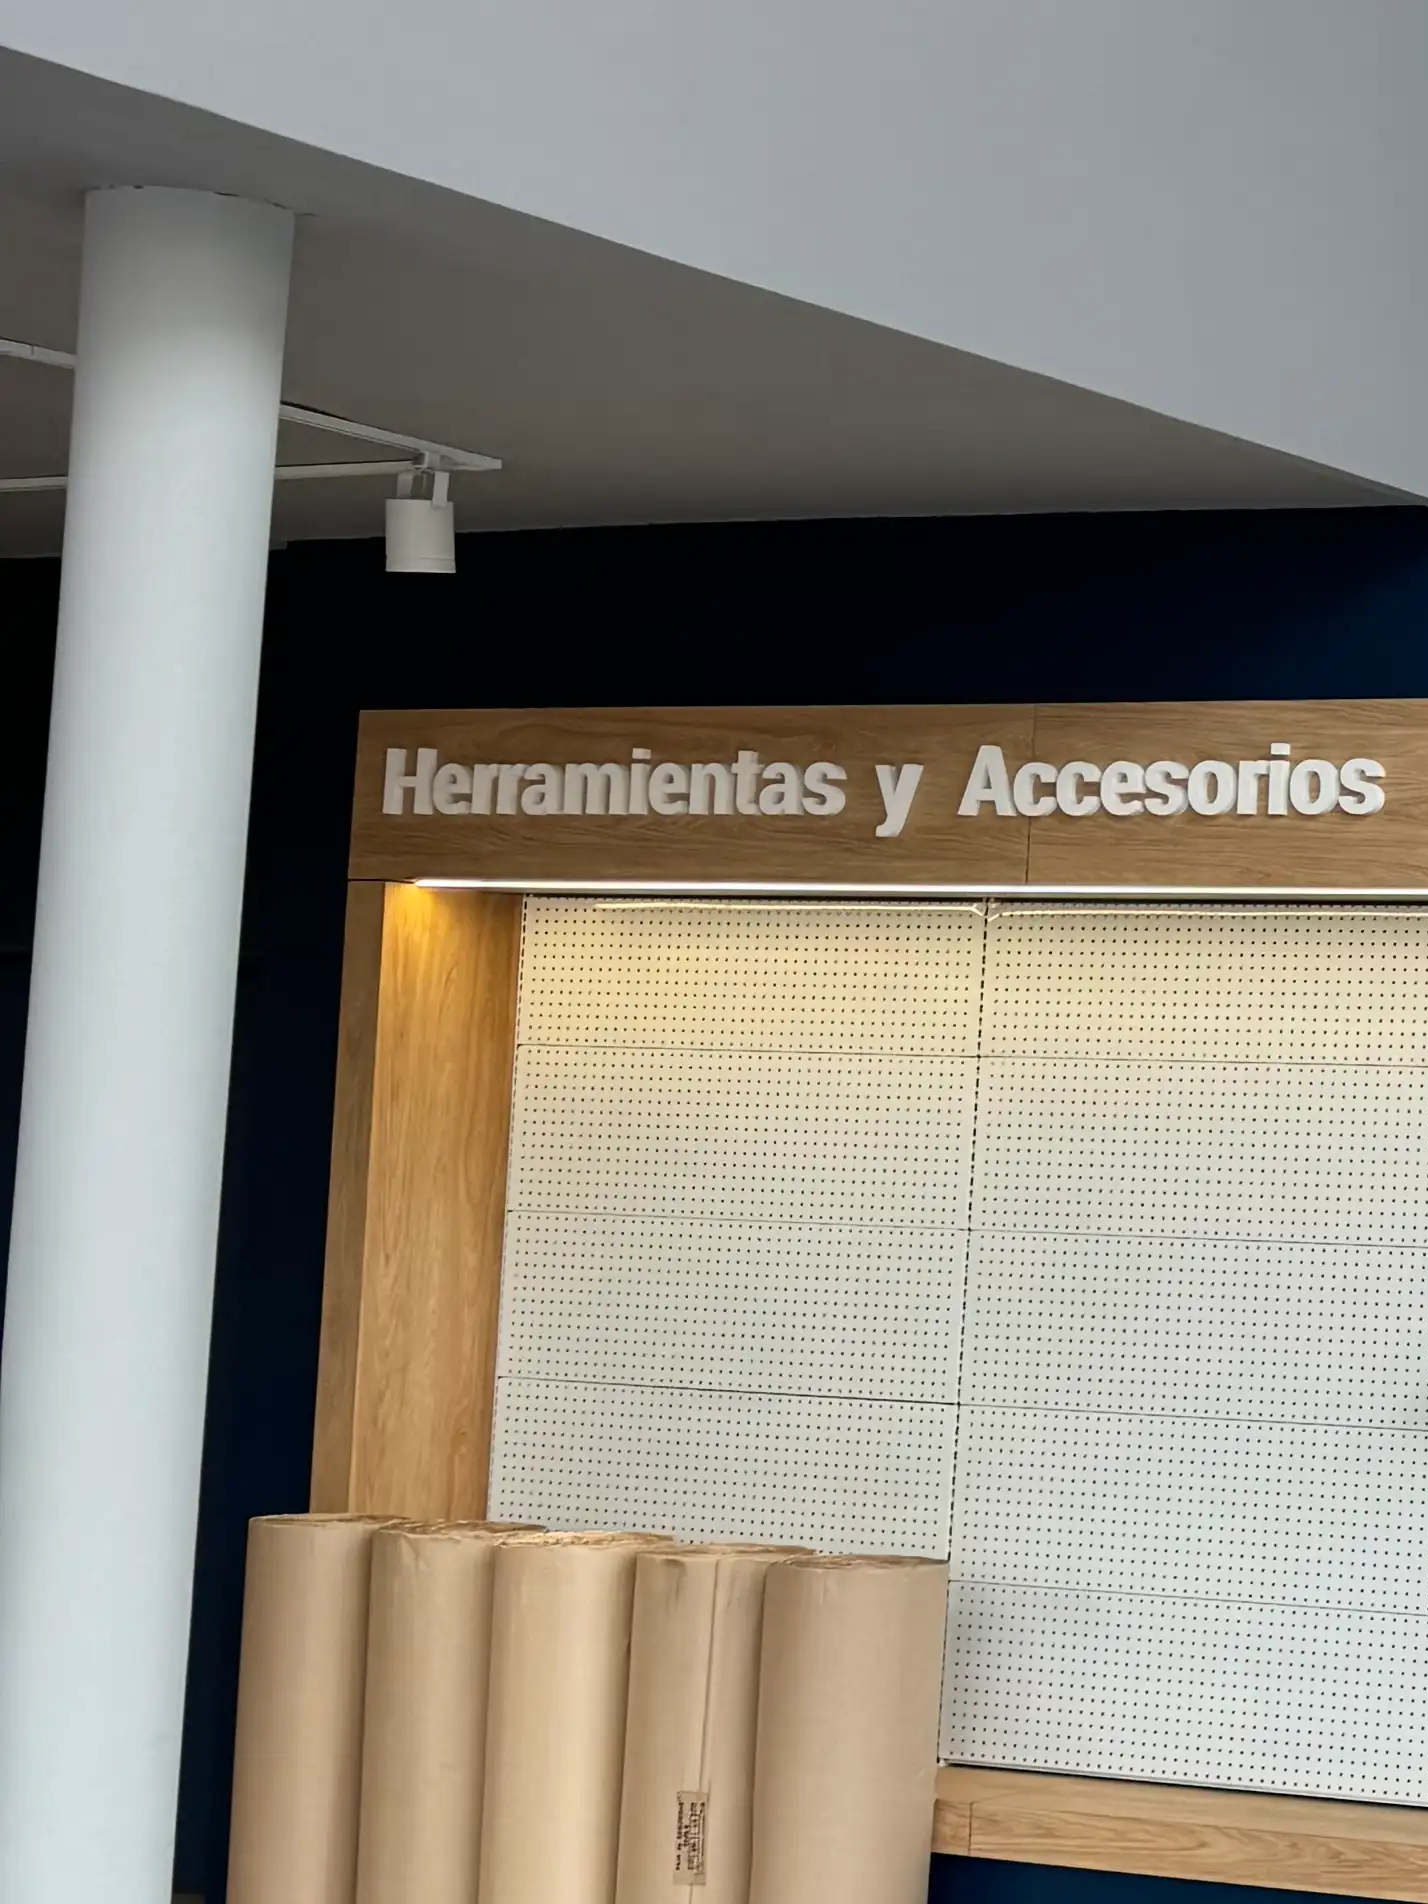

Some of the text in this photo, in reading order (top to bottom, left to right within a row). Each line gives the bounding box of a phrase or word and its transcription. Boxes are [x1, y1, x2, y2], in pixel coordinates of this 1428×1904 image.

[382, 741, 1387, 837] Herramientas y Accesorios
